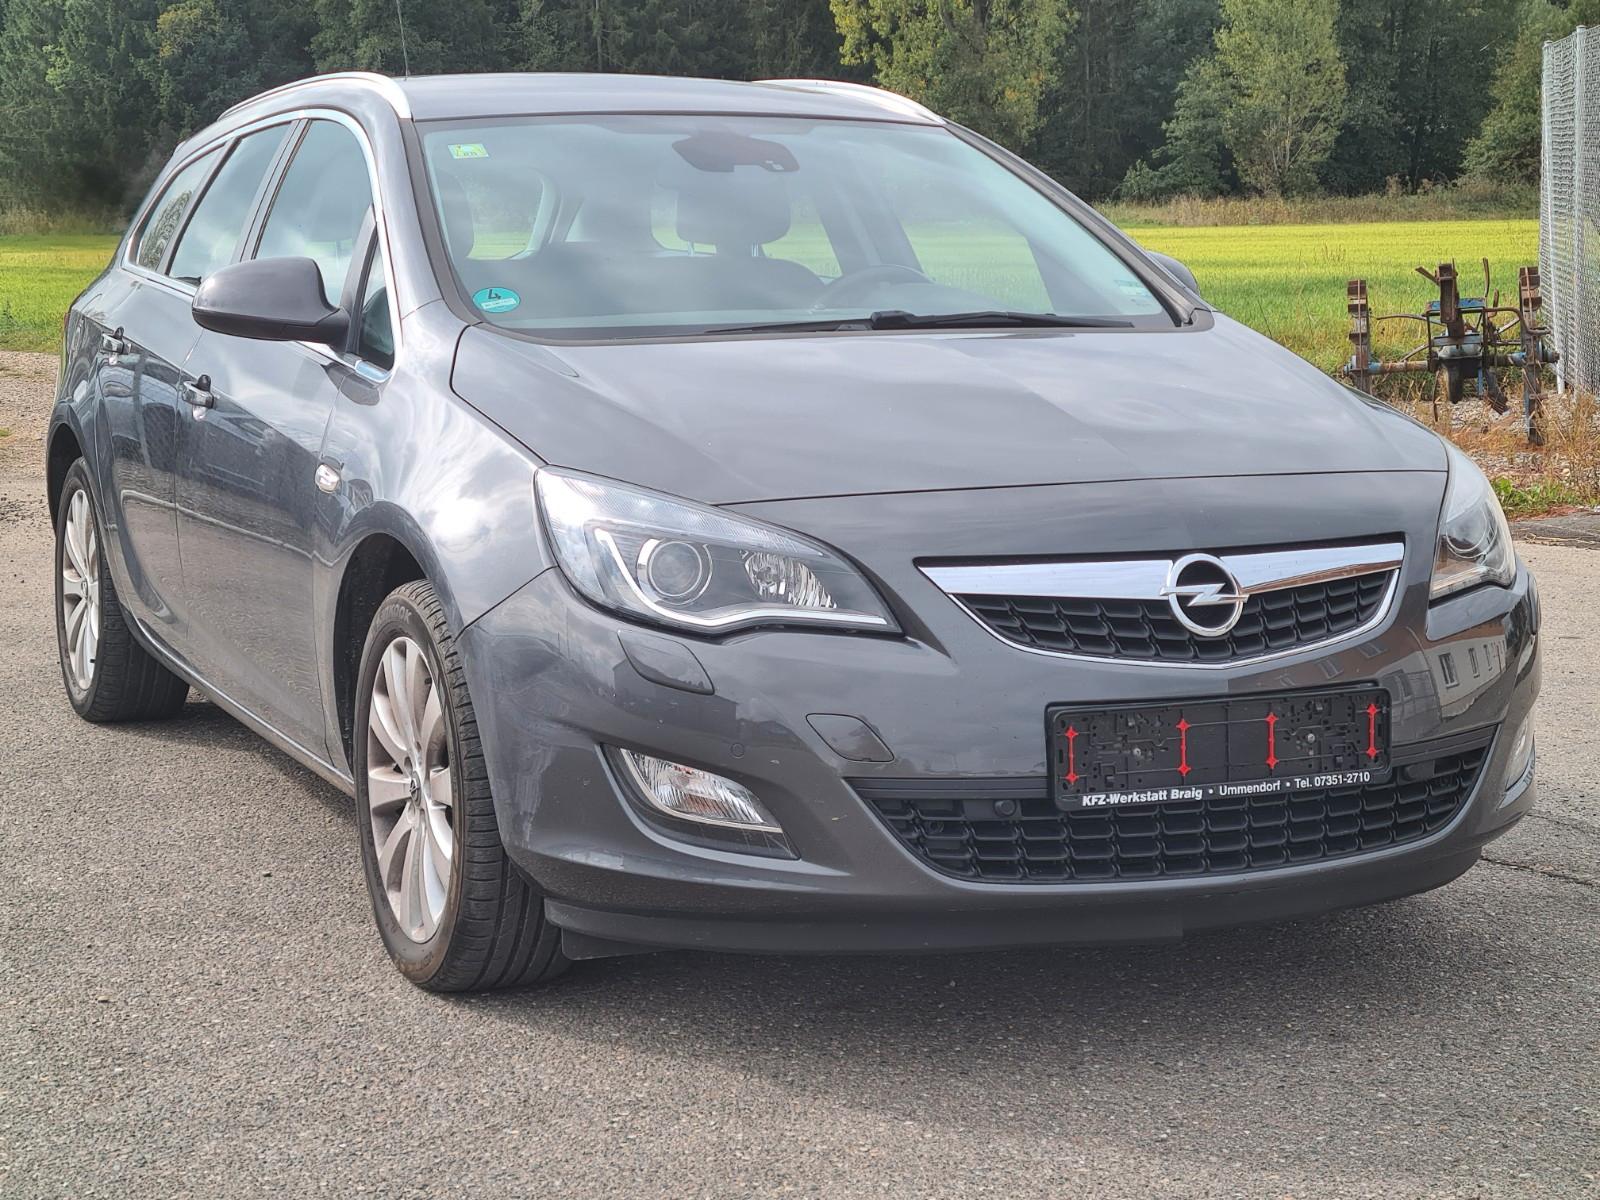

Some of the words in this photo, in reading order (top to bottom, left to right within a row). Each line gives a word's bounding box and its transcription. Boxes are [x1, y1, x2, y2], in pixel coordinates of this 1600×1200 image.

[488, 289, 501, 299] 4
[1082, 789, 1168, 807] KFZ-Werkstatt
[1170, 787, 1203, 800] Braig
[1219, 780, 1281, 796] Ummendorf
[1294, 778, 1313, 789] Tel.
[1314, 771, 1371, 787] 07351-2710
